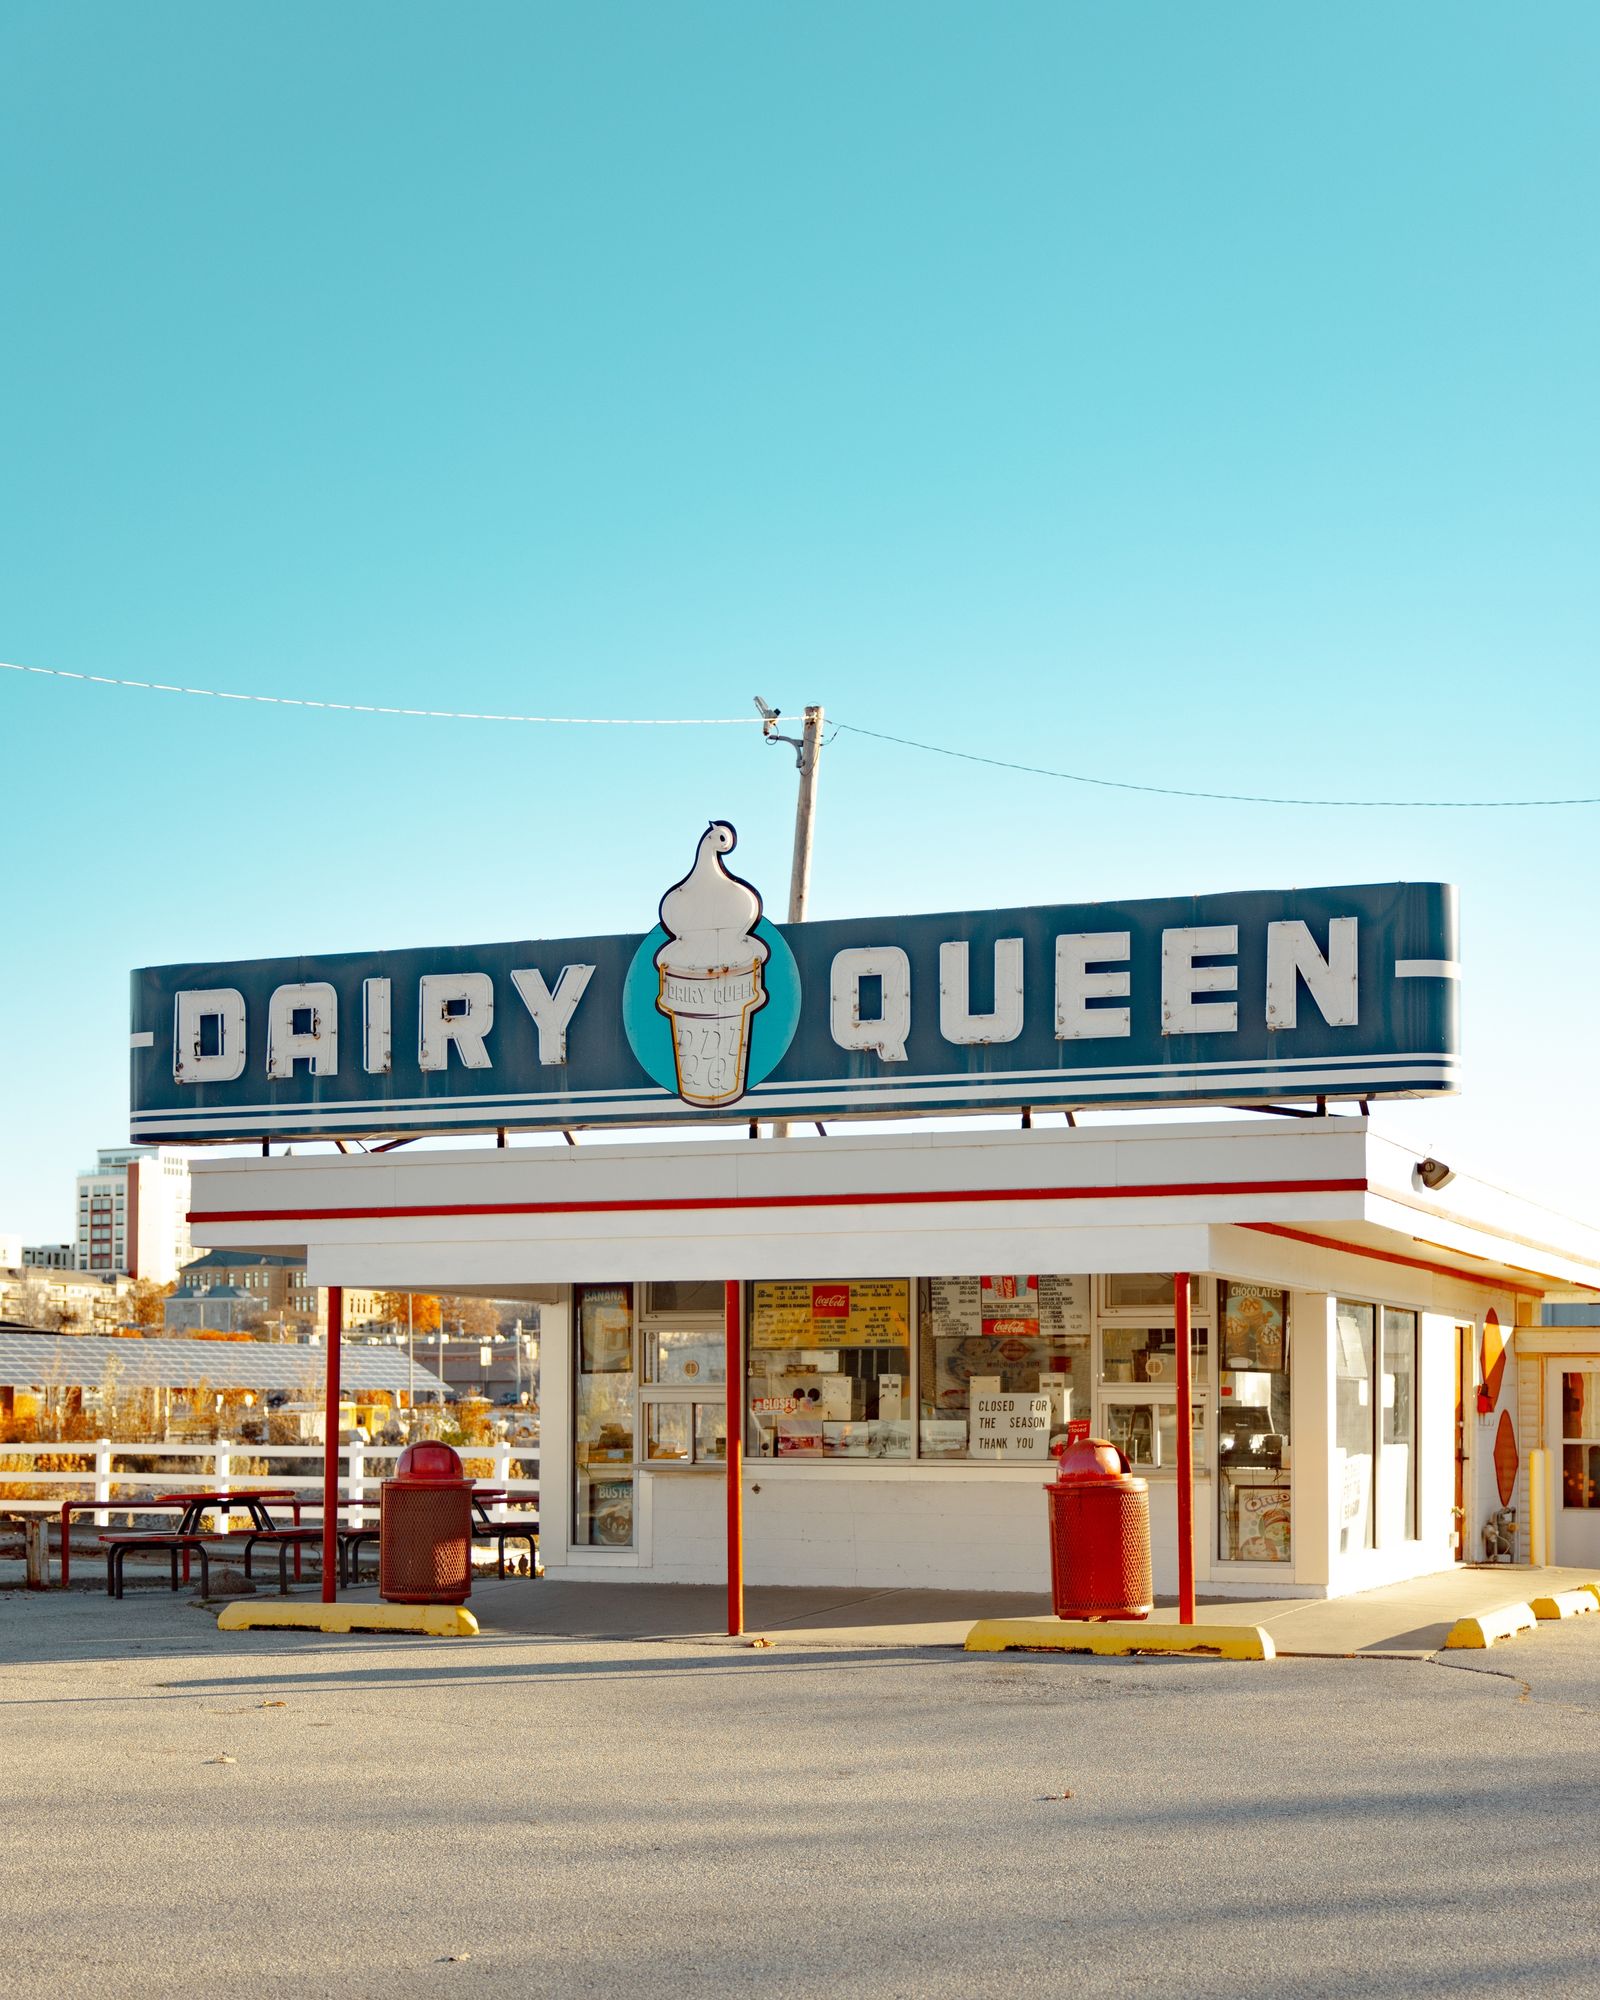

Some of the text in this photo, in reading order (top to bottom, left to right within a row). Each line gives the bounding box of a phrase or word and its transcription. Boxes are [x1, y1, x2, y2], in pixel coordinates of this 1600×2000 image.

[667, 980, 755, 1004] DAIRY QUEEN
[173, 916, 1358, 1084] DAIRY QUEEN
[584, 1291, 624, 1302] BANANA
[1231, 1286, 1281, 1298] CHOCOLATES
[815, 1295, 846, 1307] Coca-Cola
[763, 1398, 796, 1410] CLOSED
[978, 1400, 1047, 1412] CLOSED FOR
[979, 1417, 1045, 1429] THE SEASON
[979, 1438, 1034, 1449] THANK YOU
[1245, 1493, 1290, 1512] OREO
